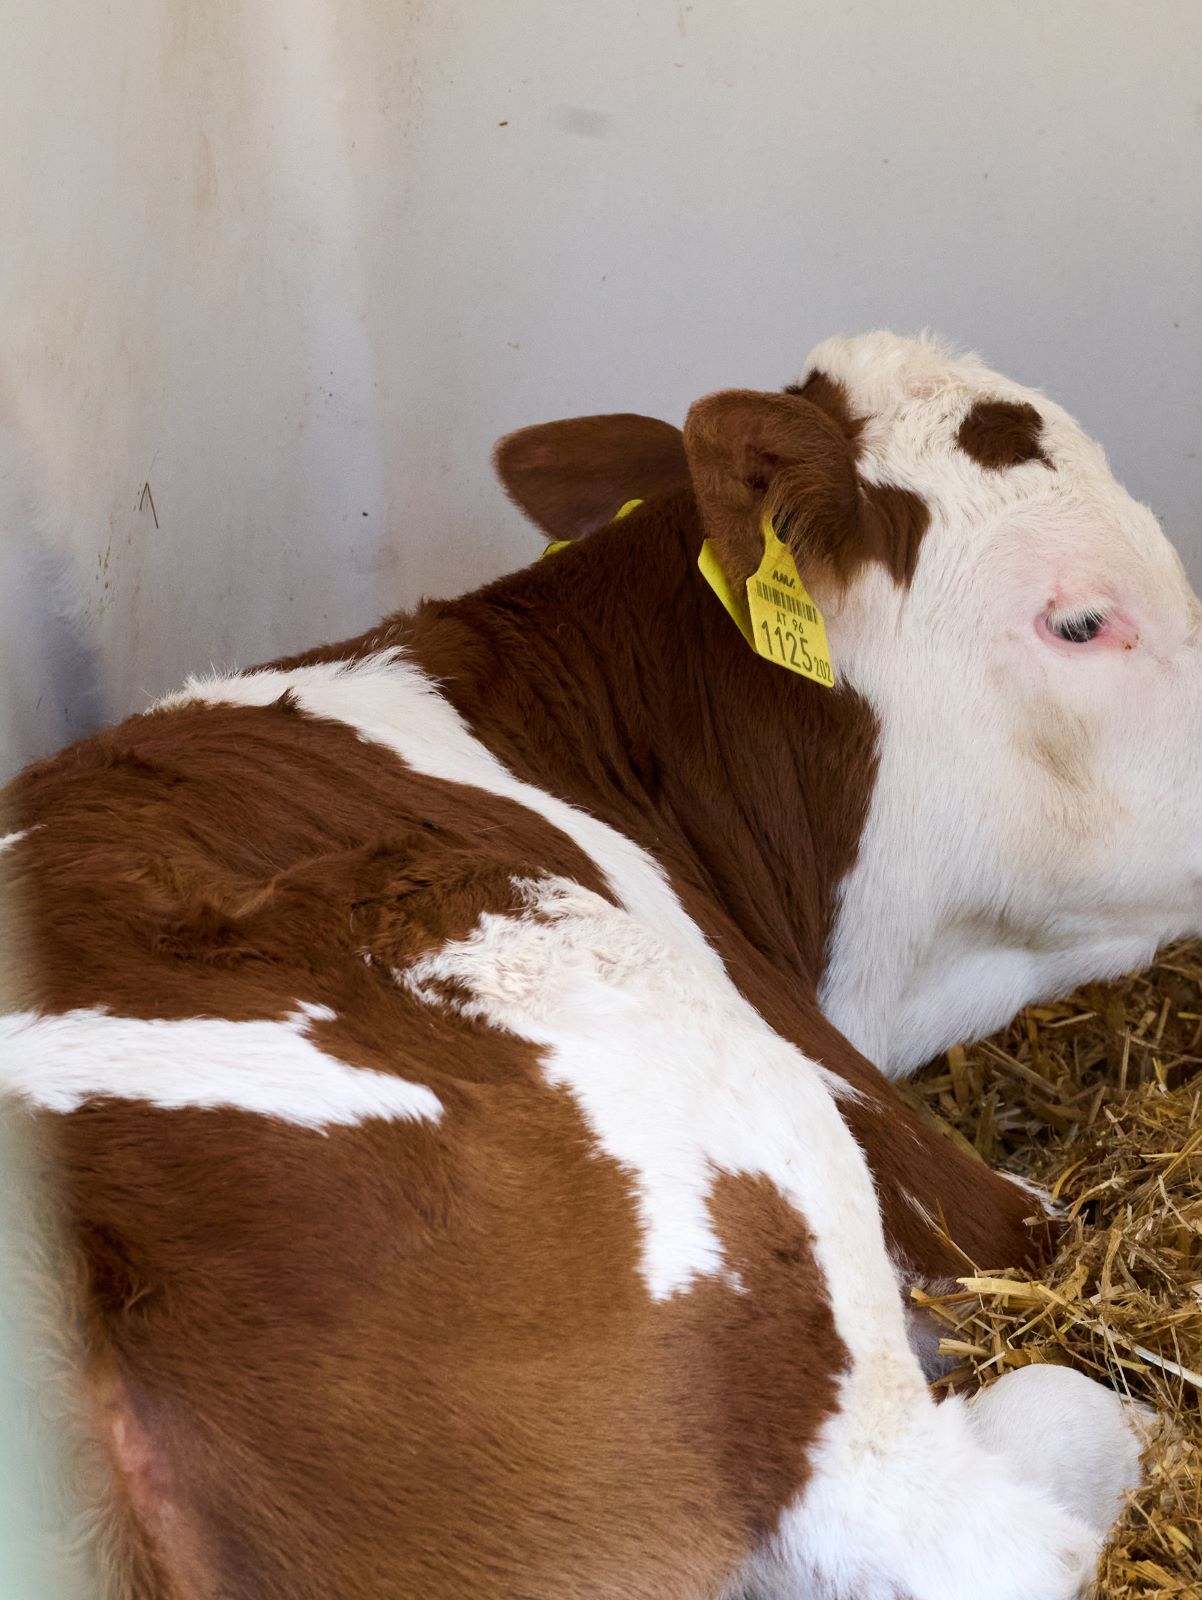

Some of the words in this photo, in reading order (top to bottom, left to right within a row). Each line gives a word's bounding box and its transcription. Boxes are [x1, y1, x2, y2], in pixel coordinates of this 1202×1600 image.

[776, 611, 787, 627] AT
[792, 618, 804, 633] 96
[762, 619, 813, 673] 1125
[813, 657, 832, 683] 202
